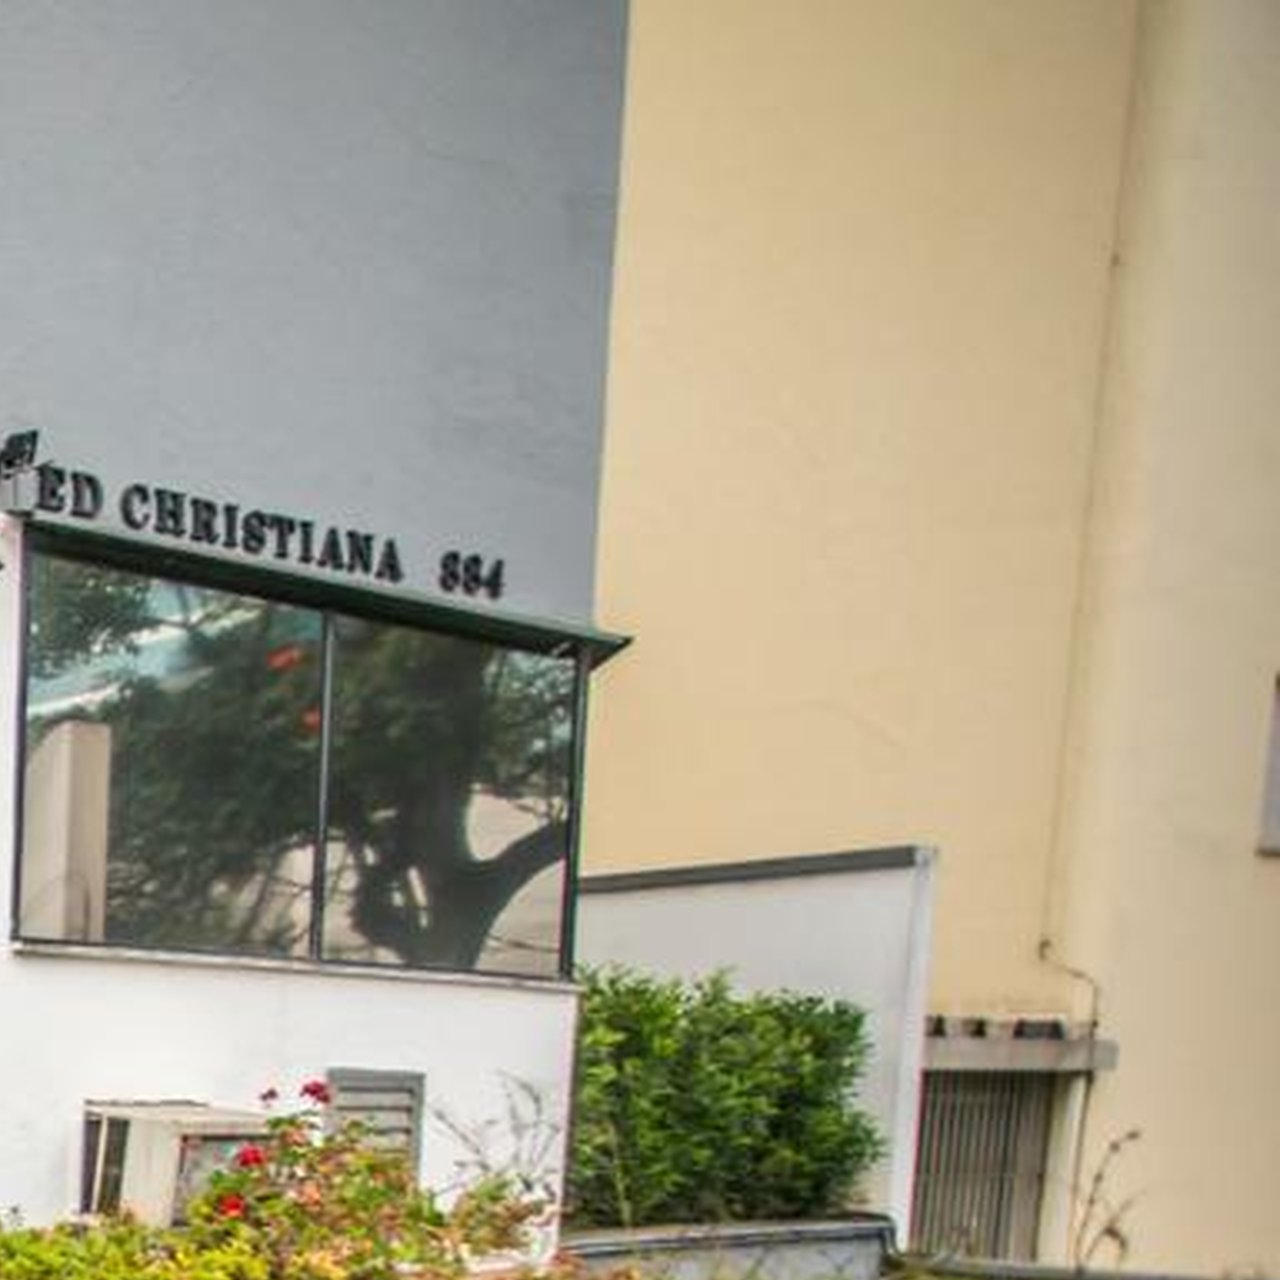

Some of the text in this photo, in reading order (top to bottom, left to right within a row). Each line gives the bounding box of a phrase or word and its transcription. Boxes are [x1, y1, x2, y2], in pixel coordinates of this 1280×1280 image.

[37, 463, 505, 599] ED CHRISTIANA 884
